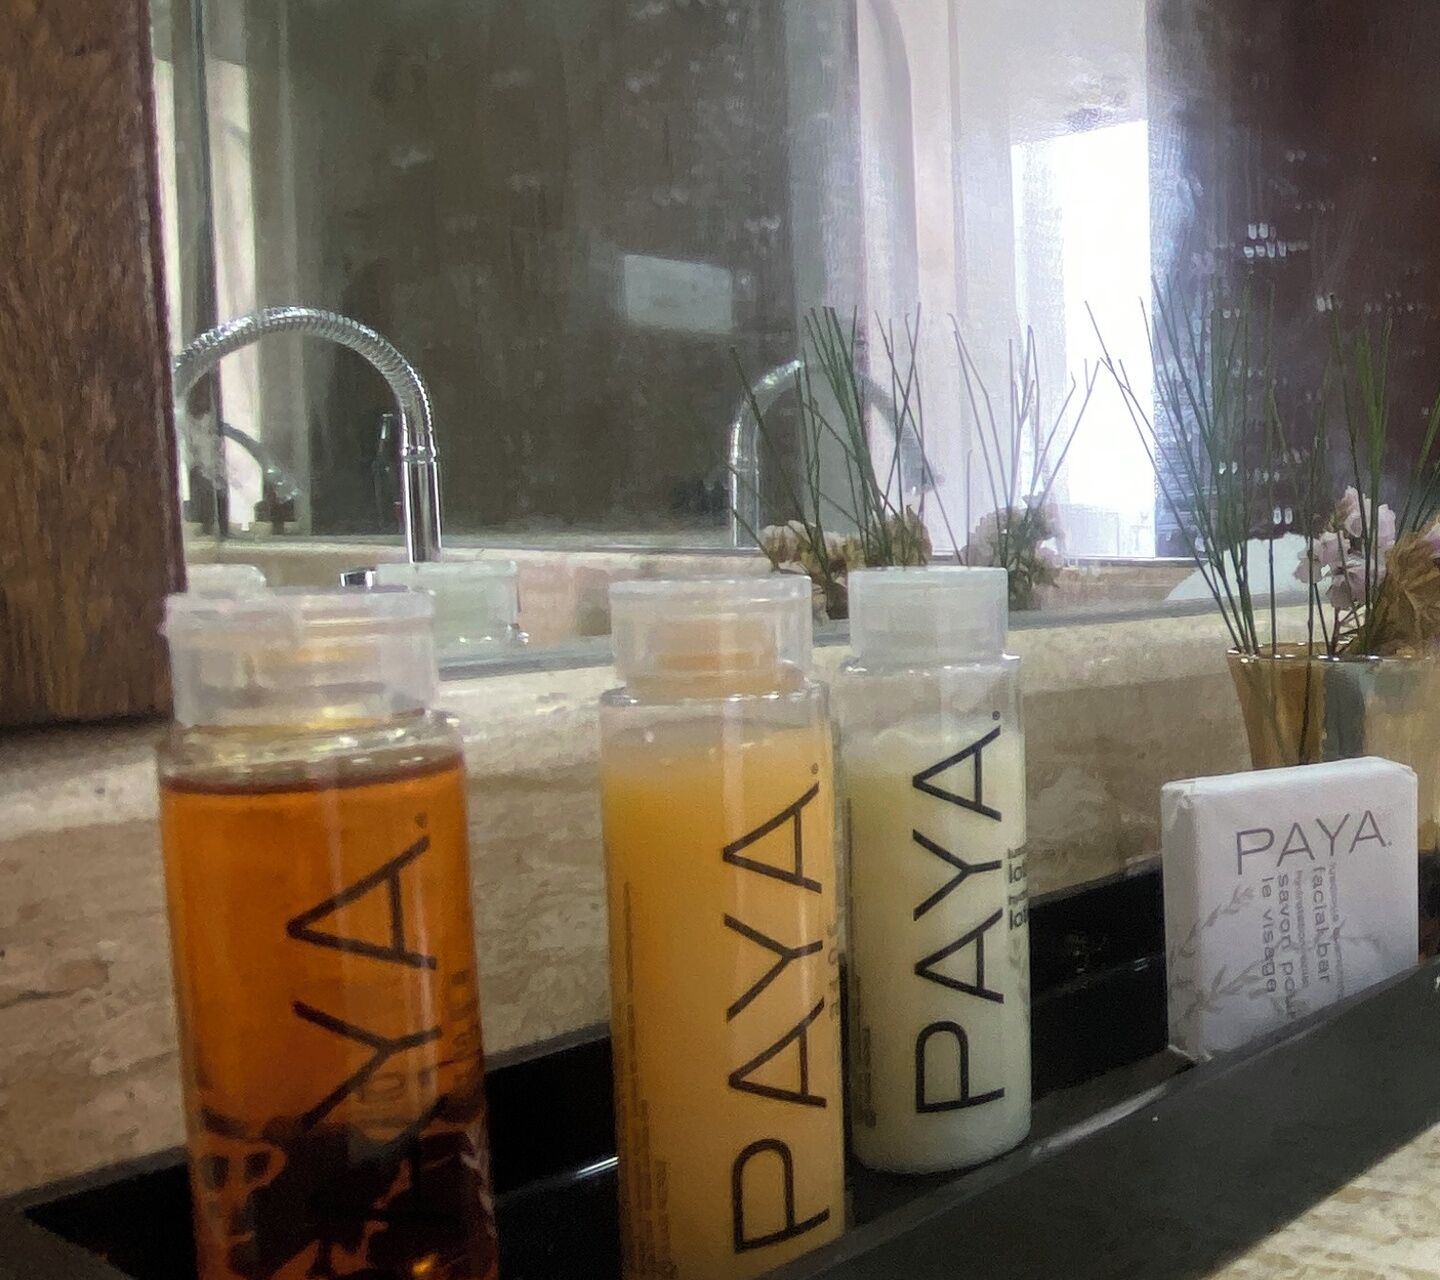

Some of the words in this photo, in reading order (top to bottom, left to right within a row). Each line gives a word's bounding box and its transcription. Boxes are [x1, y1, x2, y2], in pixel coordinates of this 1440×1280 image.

[1235, 810, 1387, 876] PAYA
[912, 723, 1006, 1115] PAYA
[1261, 876, 1275, 898] le
[1277, 873, 1292, 950] savon
[1312, 866, 1330, 934] facial
[1261, 909, 1278, 994] visage
[1316, 941, 1332, 984] bar
[721, 781, 831, 1256] PAYA
